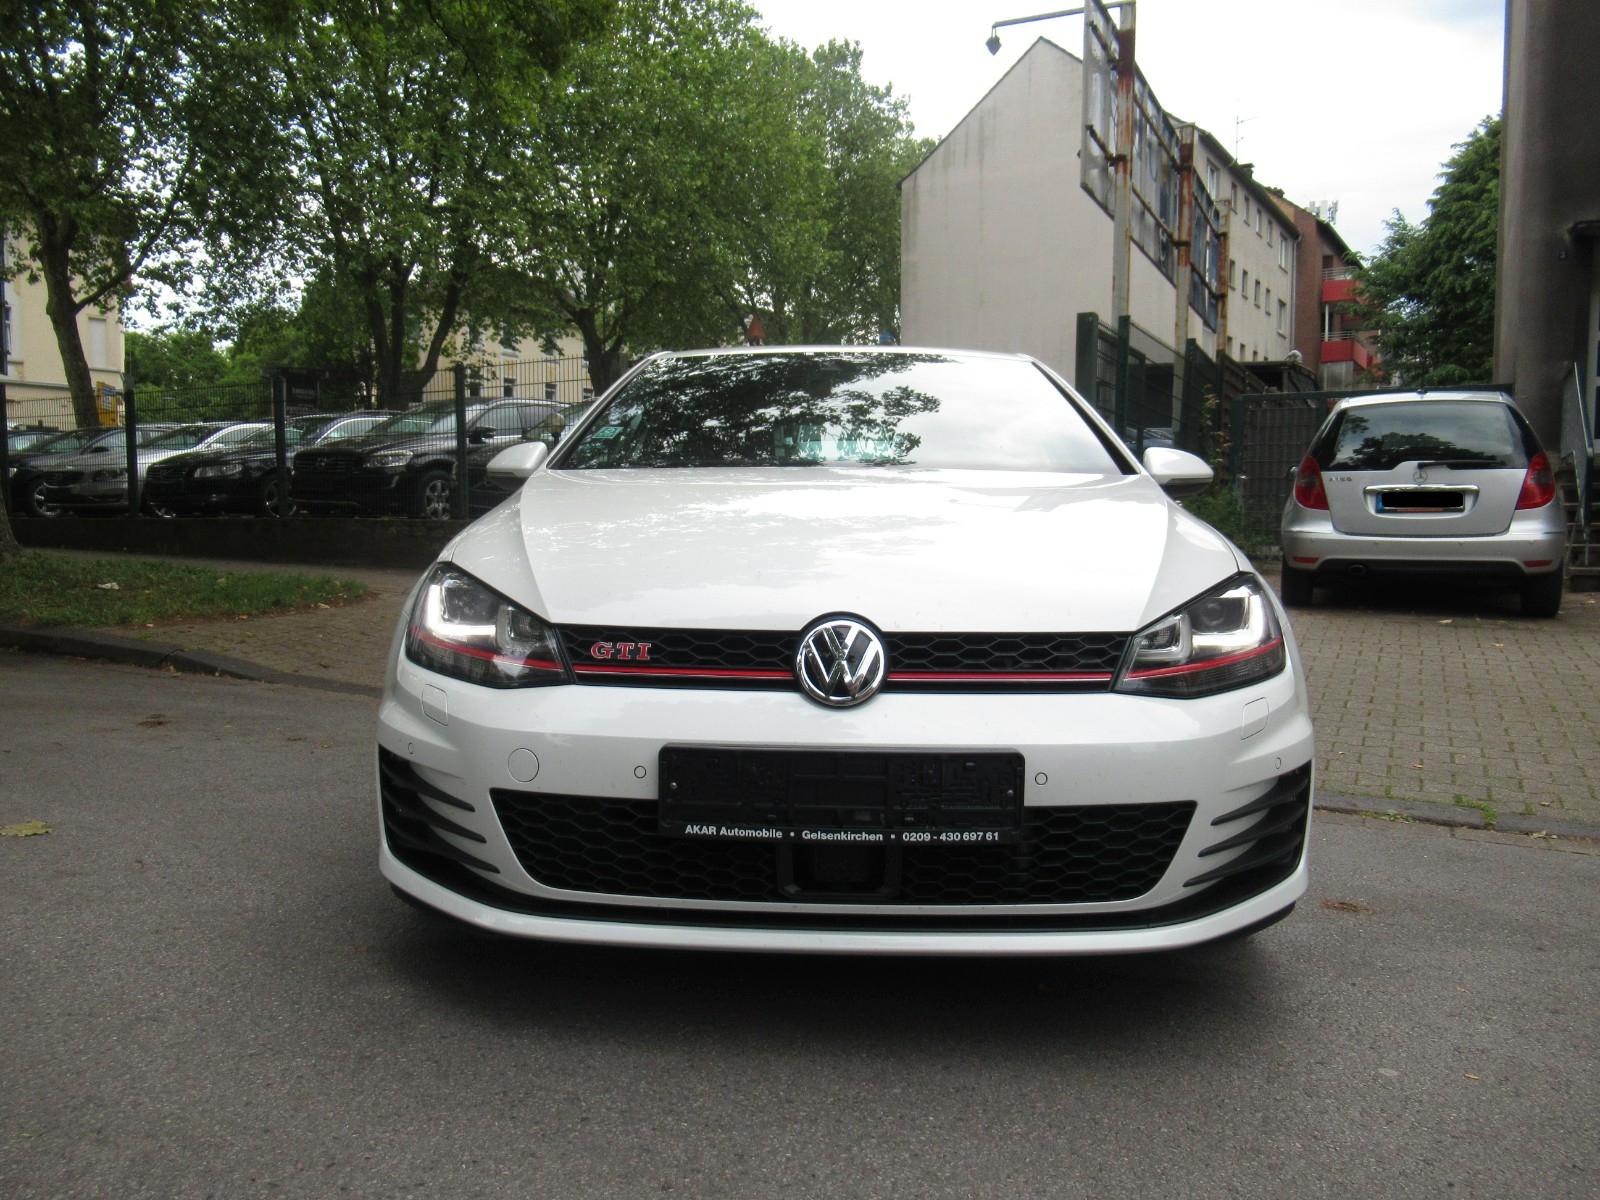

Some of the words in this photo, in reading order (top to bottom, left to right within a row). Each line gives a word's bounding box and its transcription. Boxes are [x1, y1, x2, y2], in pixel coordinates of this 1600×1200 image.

[590, 641, 652, 660] GTI
[685, 825, 717, 836] AKAR
[720, 826, 783, 838] Automobile
[802, 830, 883, 841] Gelsenkirchen
[986, 831, 999, 841] 61
